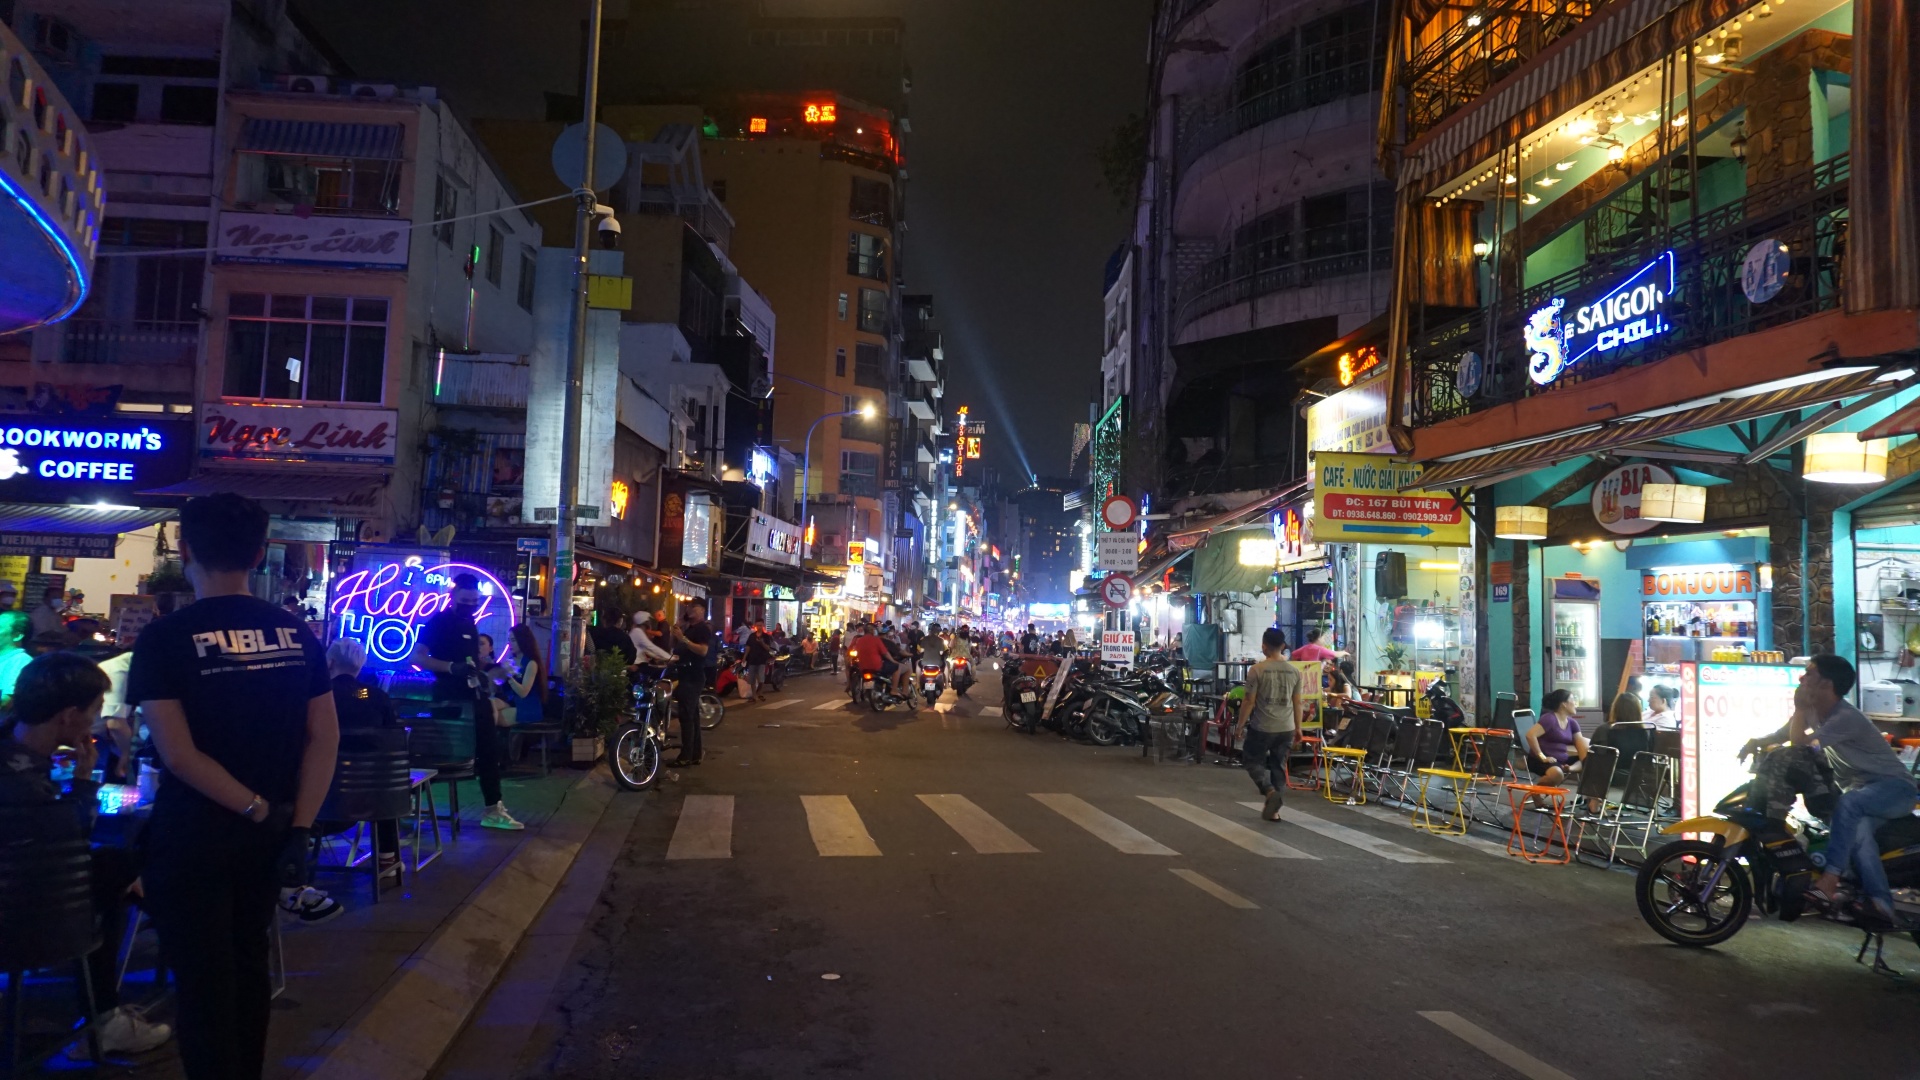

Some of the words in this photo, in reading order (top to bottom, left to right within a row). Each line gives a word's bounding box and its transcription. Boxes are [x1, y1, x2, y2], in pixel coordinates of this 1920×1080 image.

[1577, 283, 1663, 334] SAIGON
[0, 428, 162, 450] OOKWORM'S
[293, 421, 389, 449] Linh
[889, 422, 899, 477] MERAKI
[39, 459, 134, 480] COFFEE
[1323, 462, 1345, 487] CAFÉ
[1353, 464, 1376, 489] NƯỚC
[1620, 466, 1653, 496] BIA
[1345, 498, 1364, 507] ĐC:
[1368, 499, 1387, 508] 167
[1391, 498, 1411, 509] BÙI
[1414, 500, 1440, 510] VIỆN
[1346, 510, 1396, 520] 0938.648.860
[1403, 513, 1453, 522] 0902.909.247
[1, 534, 76, 547] VIETNAMESE
[78, 537, 109, 549] FOOD
[1494, 586, 1508, 596] 169
[1643, 571, 1753, 595] BONJOUR
[192, 628, 302, 658] PUBLIC
[1122, 634, 1134, 644] XE
[1683, 666, 1696, 705] 169
